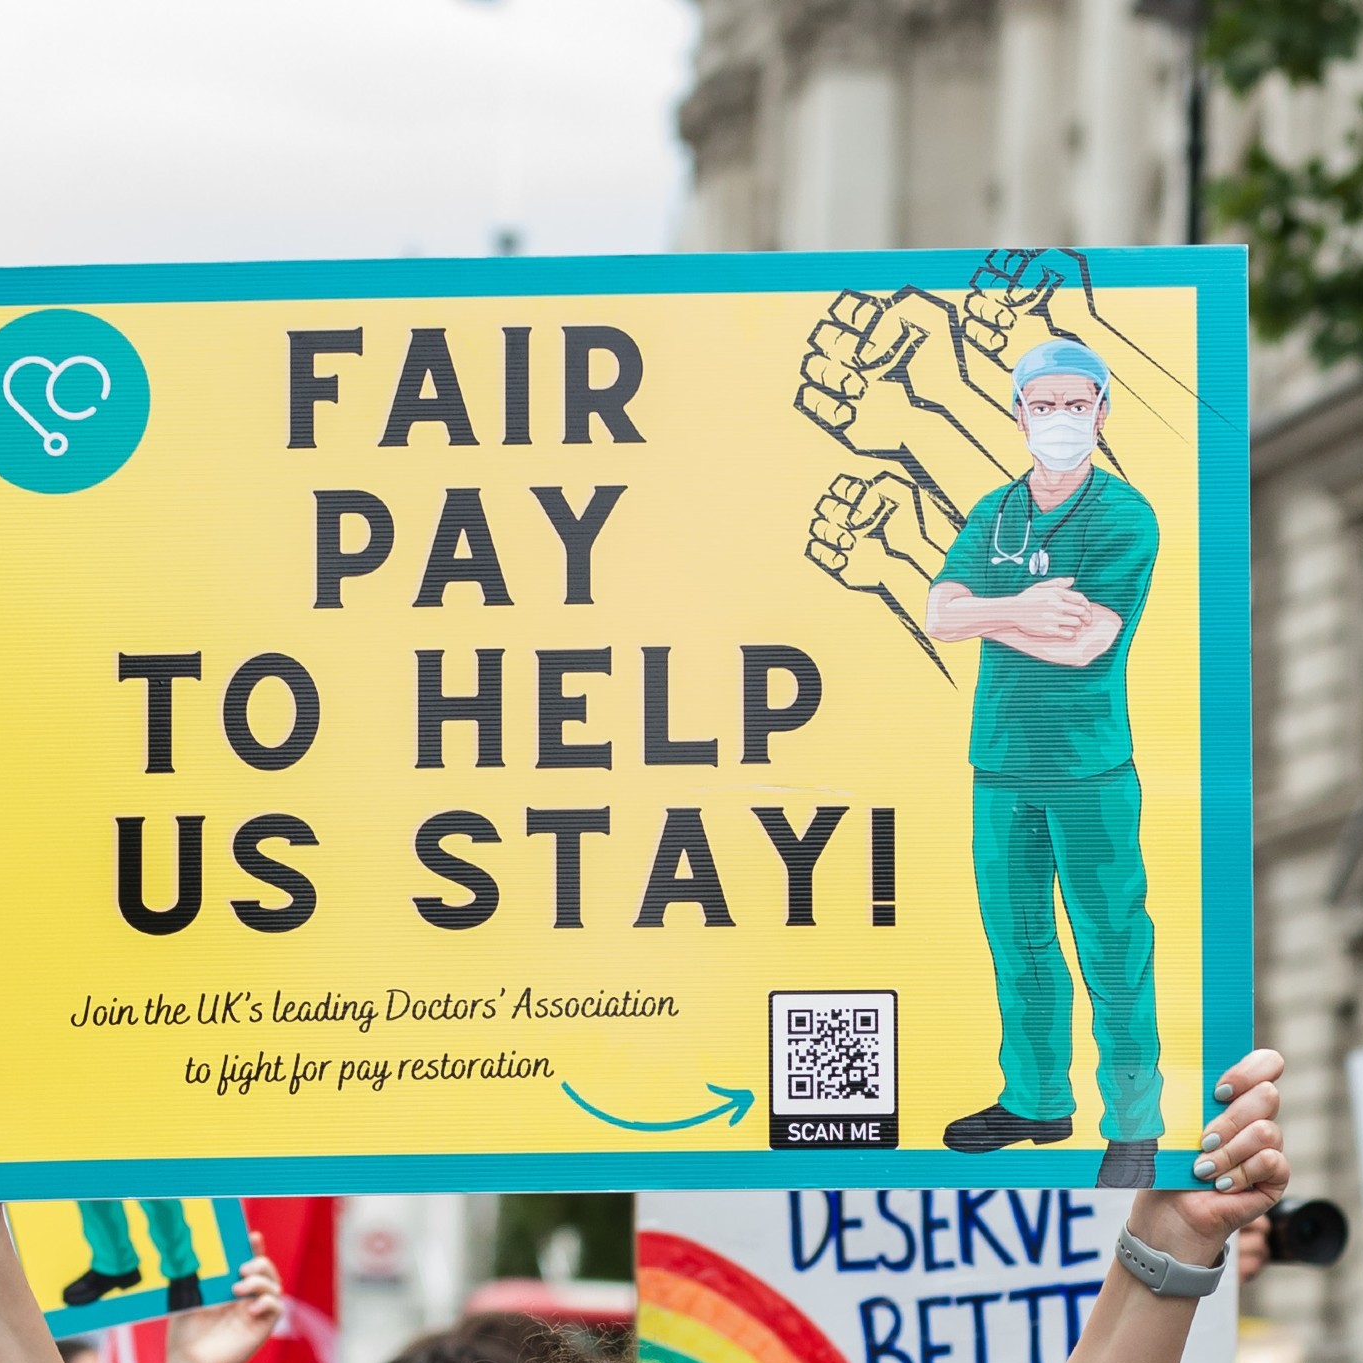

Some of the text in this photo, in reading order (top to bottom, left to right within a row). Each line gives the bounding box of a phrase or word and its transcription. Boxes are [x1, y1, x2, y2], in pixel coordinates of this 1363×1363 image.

[287, 326, 646, 448] FAIR
[313, 486, 628, 608] PAY
[119, 645, 822, 773] TO HELP
[116, 806, 895, 935] US STAY!
[71, 986, 680, 1034] Join the UK's leading Doctors' Association
[185, 1049, 555, 1096] to fight for pay restoration
[786, 1122, 881, 1143] SCAN ME
[787, 1190, 1101, 1271] DESERVE
